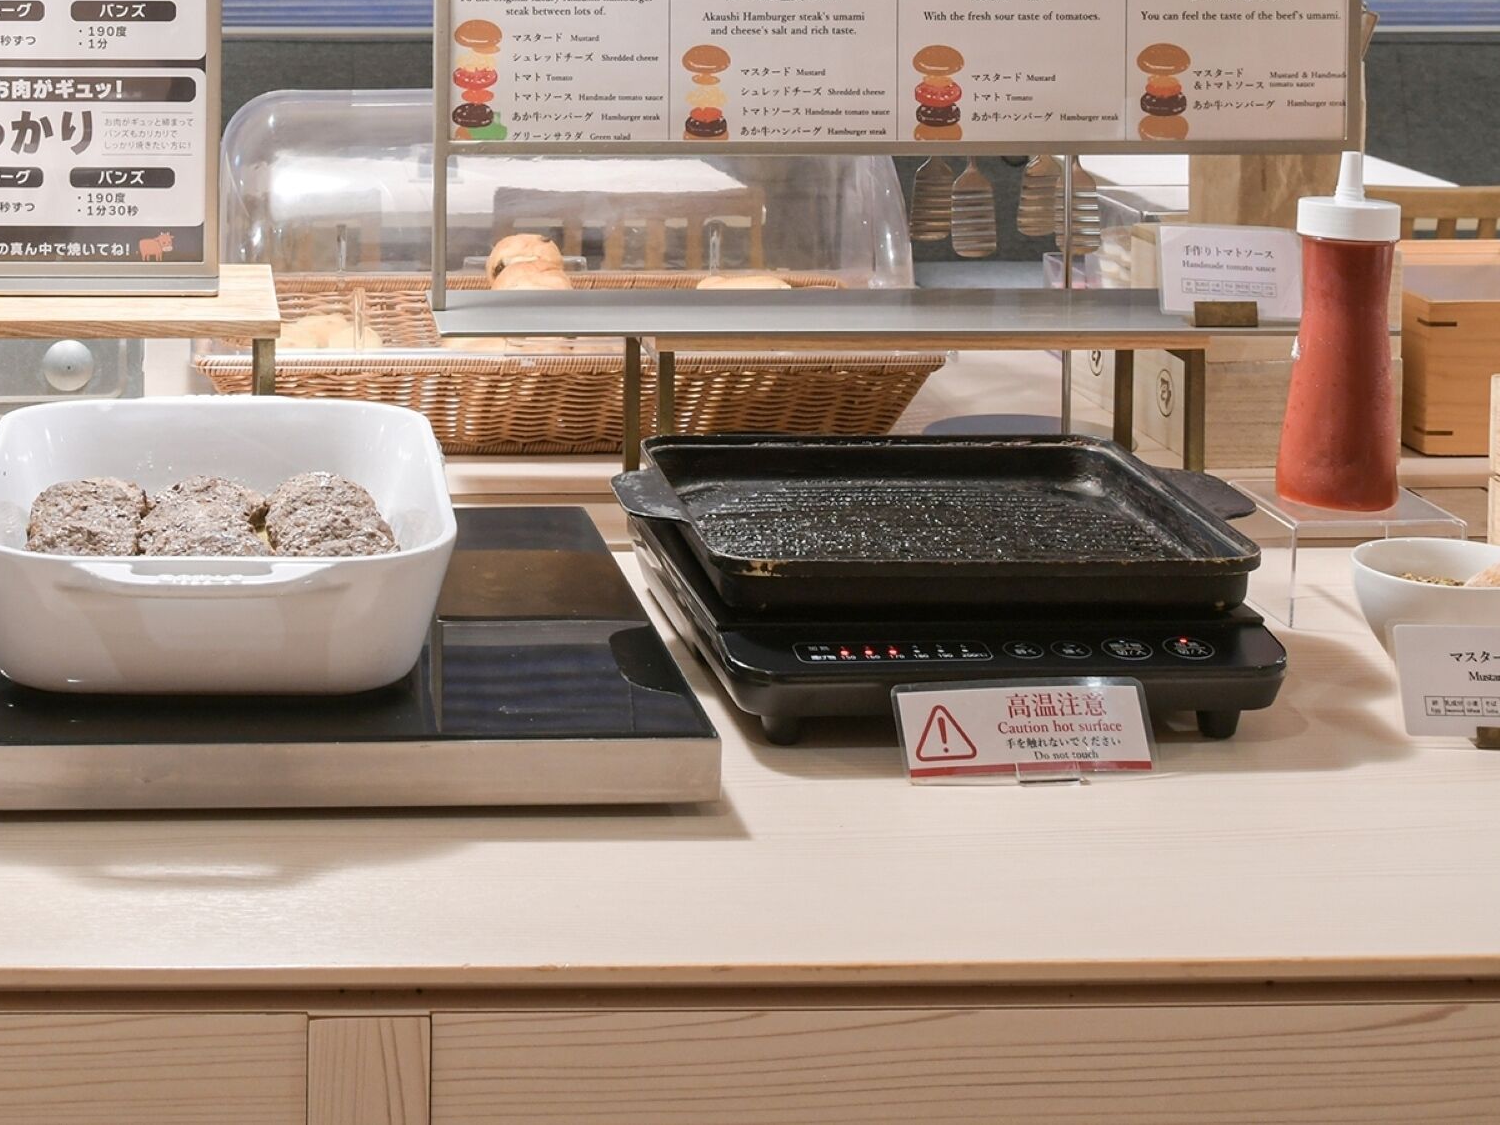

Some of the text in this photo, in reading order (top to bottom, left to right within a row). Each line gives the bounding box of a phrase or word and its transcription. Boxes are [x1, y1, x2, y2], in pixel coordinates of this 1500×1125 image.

[100, 4, 146, 17] バンズ
[506, 6, 605, 15] steak between lots of.
[924, 11, 946, 20] With
[950, 11, 965, 20] the
[968, 11, 991, 20] fresh
[1043, 11, 1053, 20] of
[1141, 11, 1159, 20] You
[1182, 11, 1199, 20] feel
[1202, 11, 1217, 20] the
[1245, 11, 1255, 20] of
[1258, 11, 1273, 20] the
[1307, 11, 1341, 20] umami.
[703, 12, 865, 23] Akaushi Hamburger steak's umami
[711, 26, 727, 35] and
[731, 26, 768, 35] cheese's
[772, 26, 787, 35] salt
[791, 26, 807, 35] and
[811, 26, 829, 35] rich
[513, 33, 562, 42] マスタード
[513, 52, 593, 62] シュレッドチーズ
[741, 67, 790, 76] マスタード
[1193, 68, 1243, 78] マスタード
[515, 72, 540, 82] トマト
[972, 72, 1021, 82] マスタード
[742, 86, 822, 96] シュレッドチーズ
[515, 92, 572, 101] トマトソース
[974, 92, 1000, 101] トマト
[743, 107, 800, 116] トマトソース
[98, 171, 144, 184] バンズ
[1185, 245, 1275, 259] 手作りトマトソース
[1007, 692, 1106, 718] 高温注意
[998, 719, 1122, 735] Caution hot surface
[1007, 736, 1120, 749] 手を触れないでください
[1034, 750, 1098, 760] Do not touch
